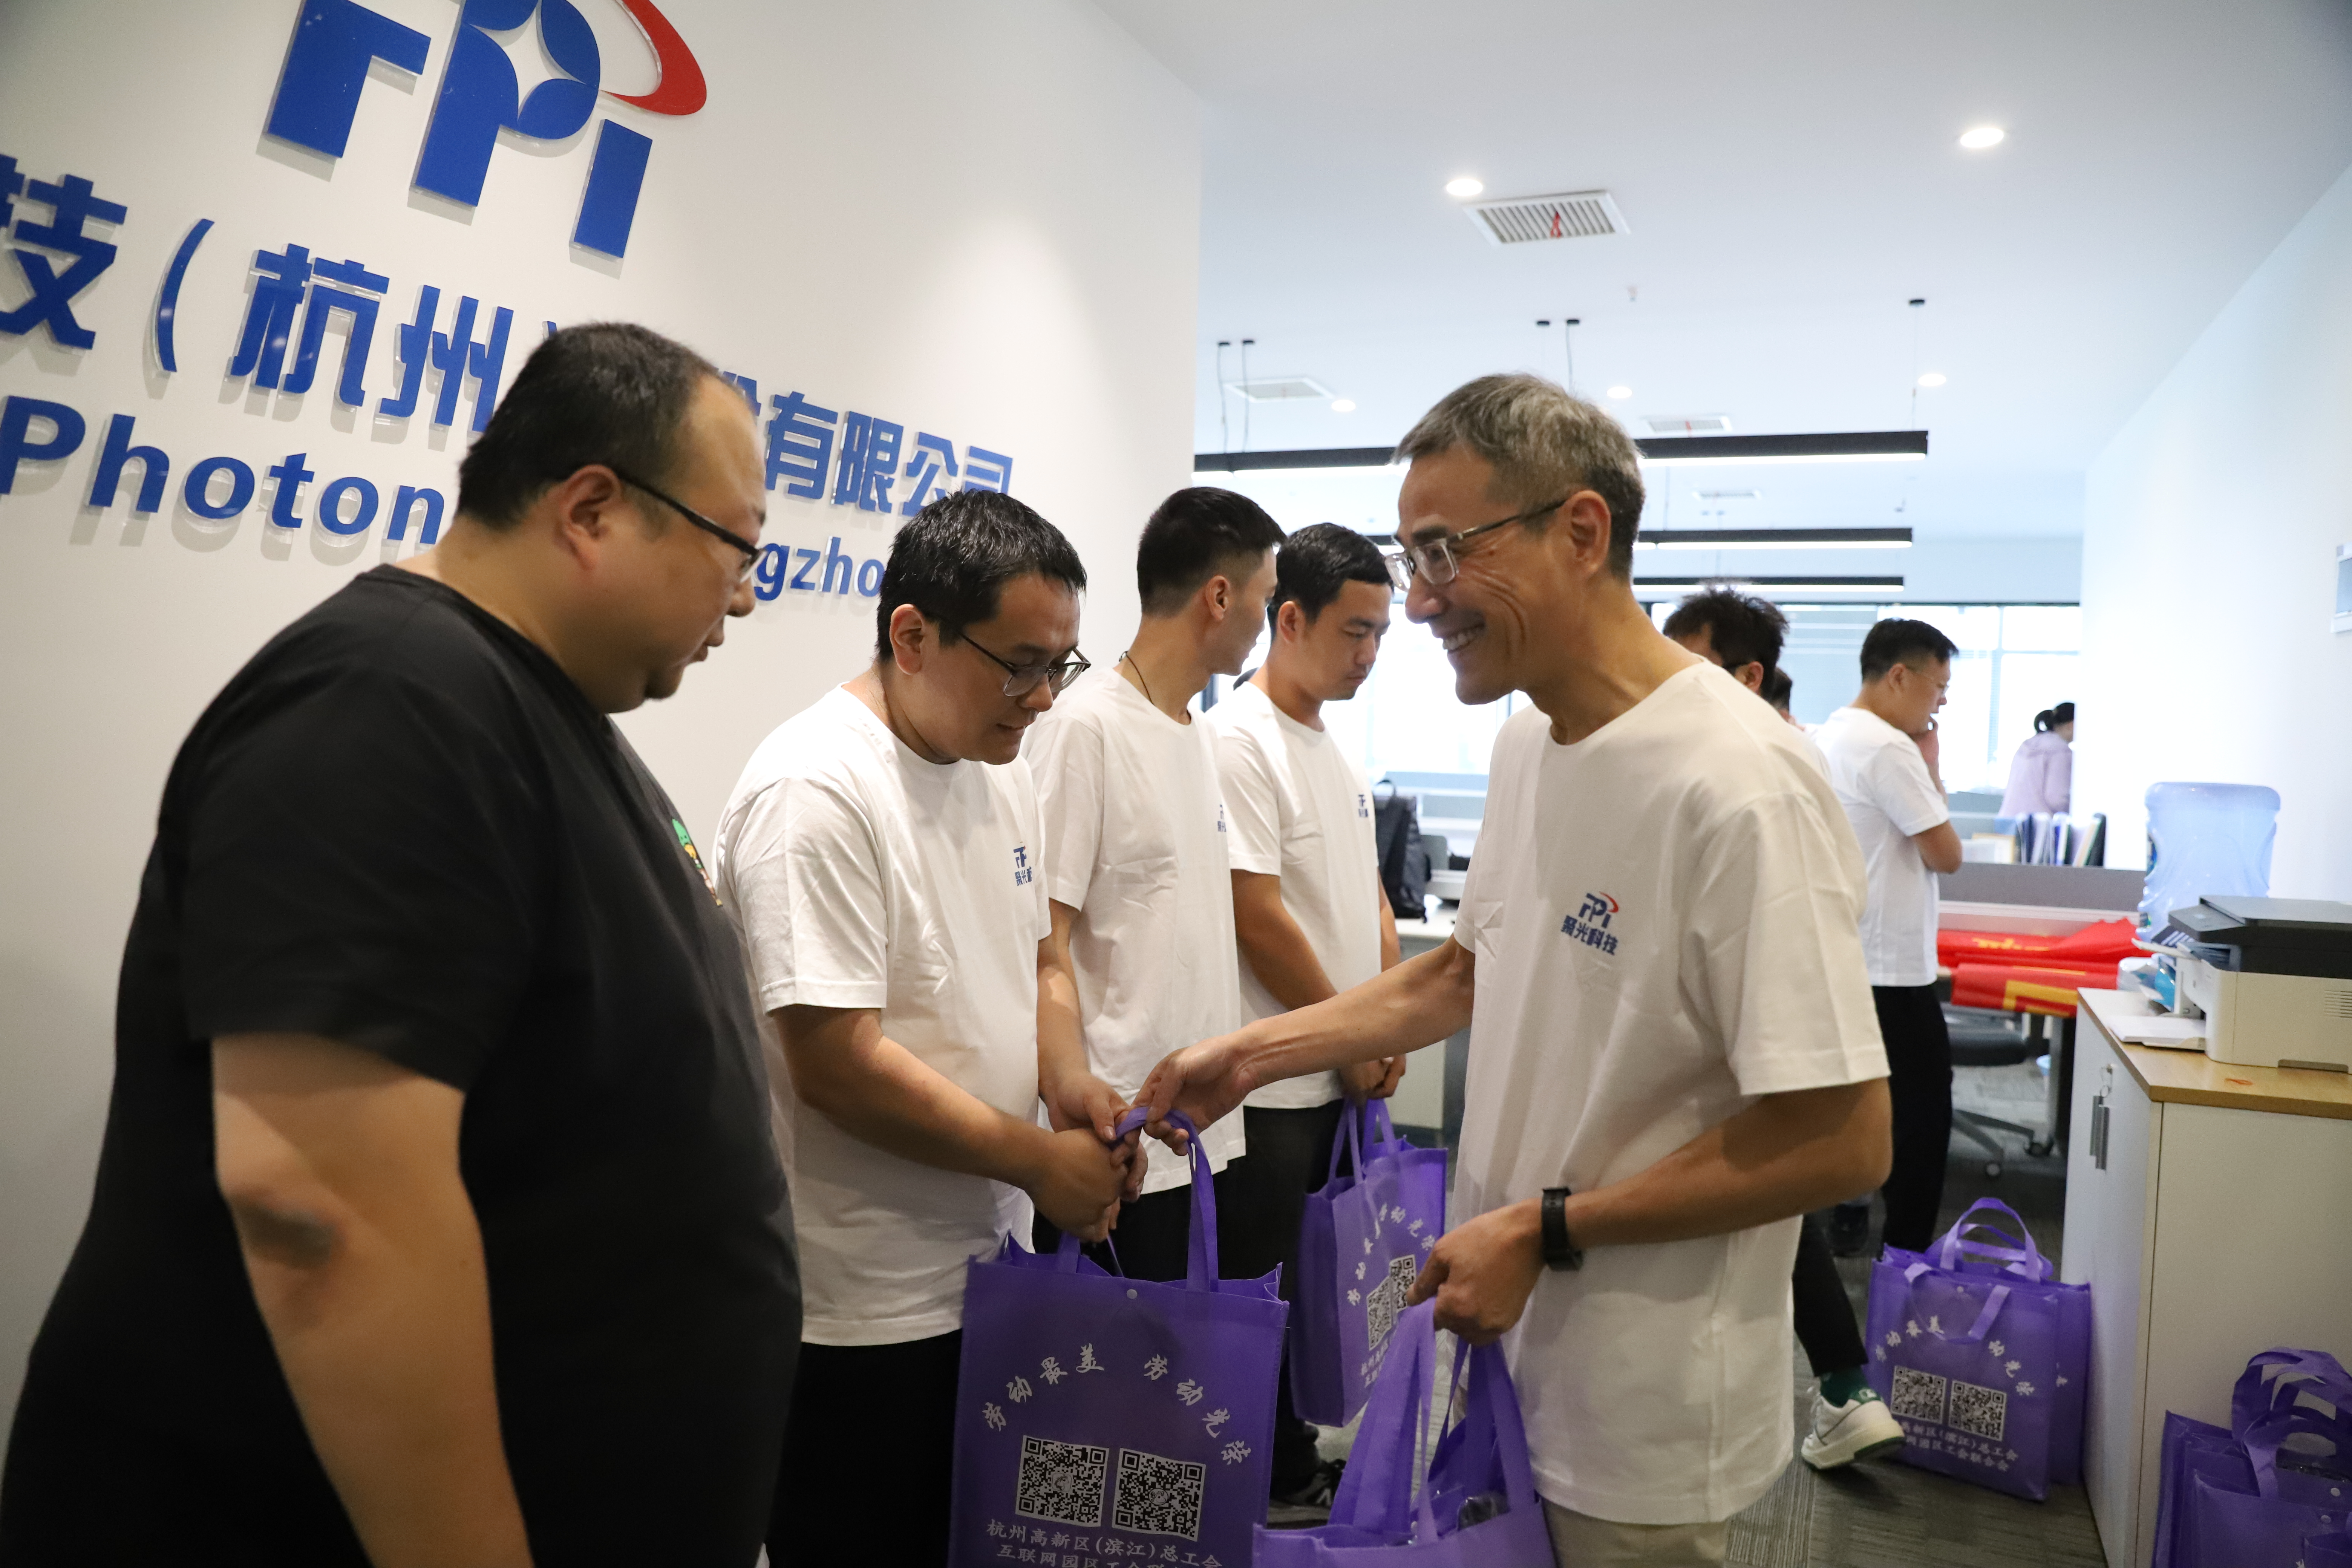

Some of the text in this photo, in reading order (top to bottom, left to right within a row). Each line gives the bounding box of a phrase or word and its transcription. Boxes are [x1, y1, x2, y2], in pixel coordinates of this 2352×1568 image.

[1560, 915, 1619, 956] 聚光科技
[982, 1343, 1252, 1465] 劳动最美 劳动光荣
